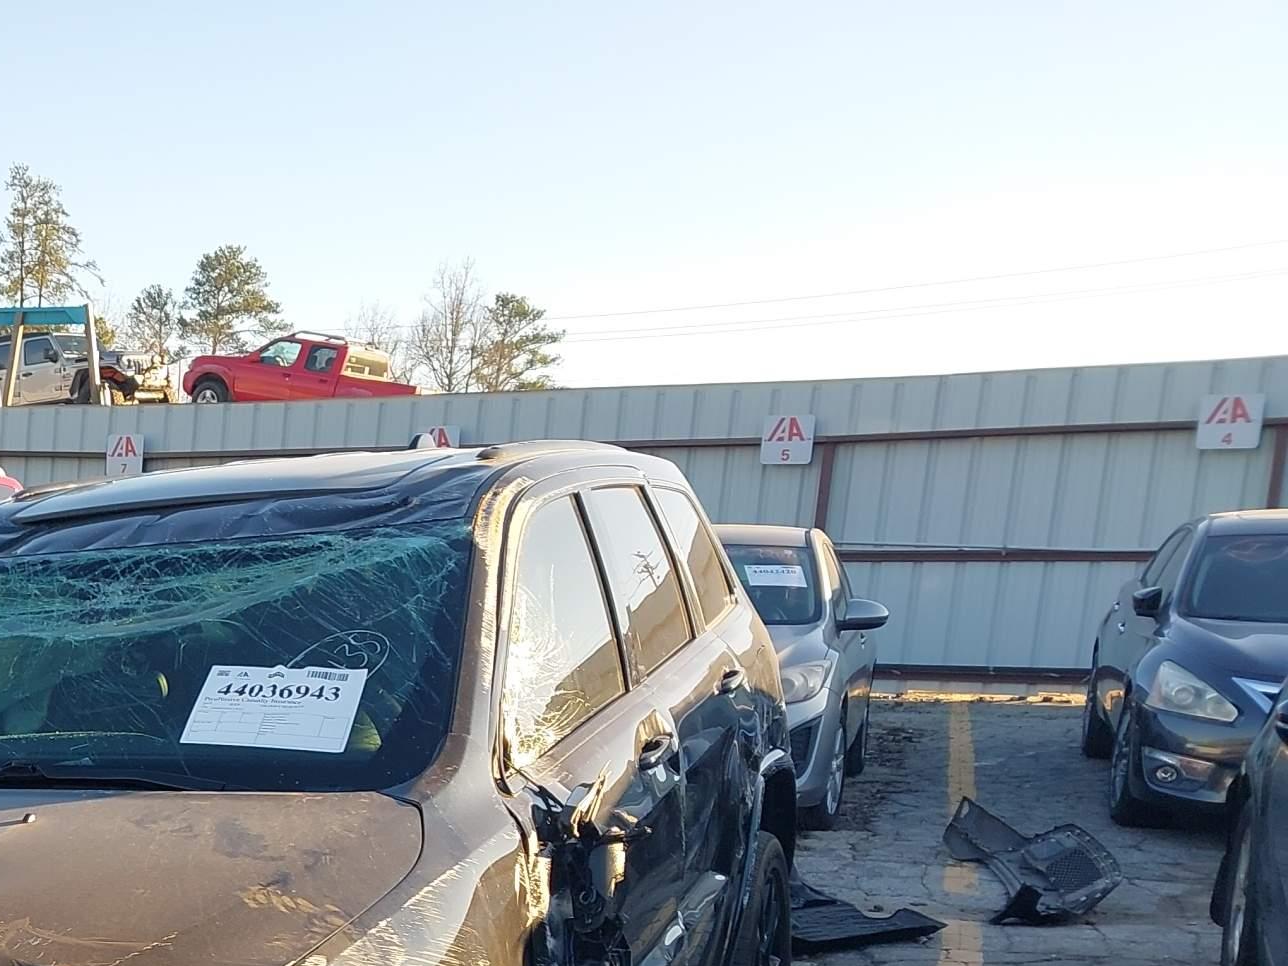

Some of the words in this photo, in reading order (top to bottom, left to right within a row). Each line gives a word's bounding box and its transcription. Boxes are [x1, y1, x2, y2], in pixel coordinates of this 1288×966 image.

[1221, 432, 1232, 445] 4
[780, 449, 790, 461] 5
[120, 463, 128, 473] 7
[216, 683, 341, 702] 44036943
